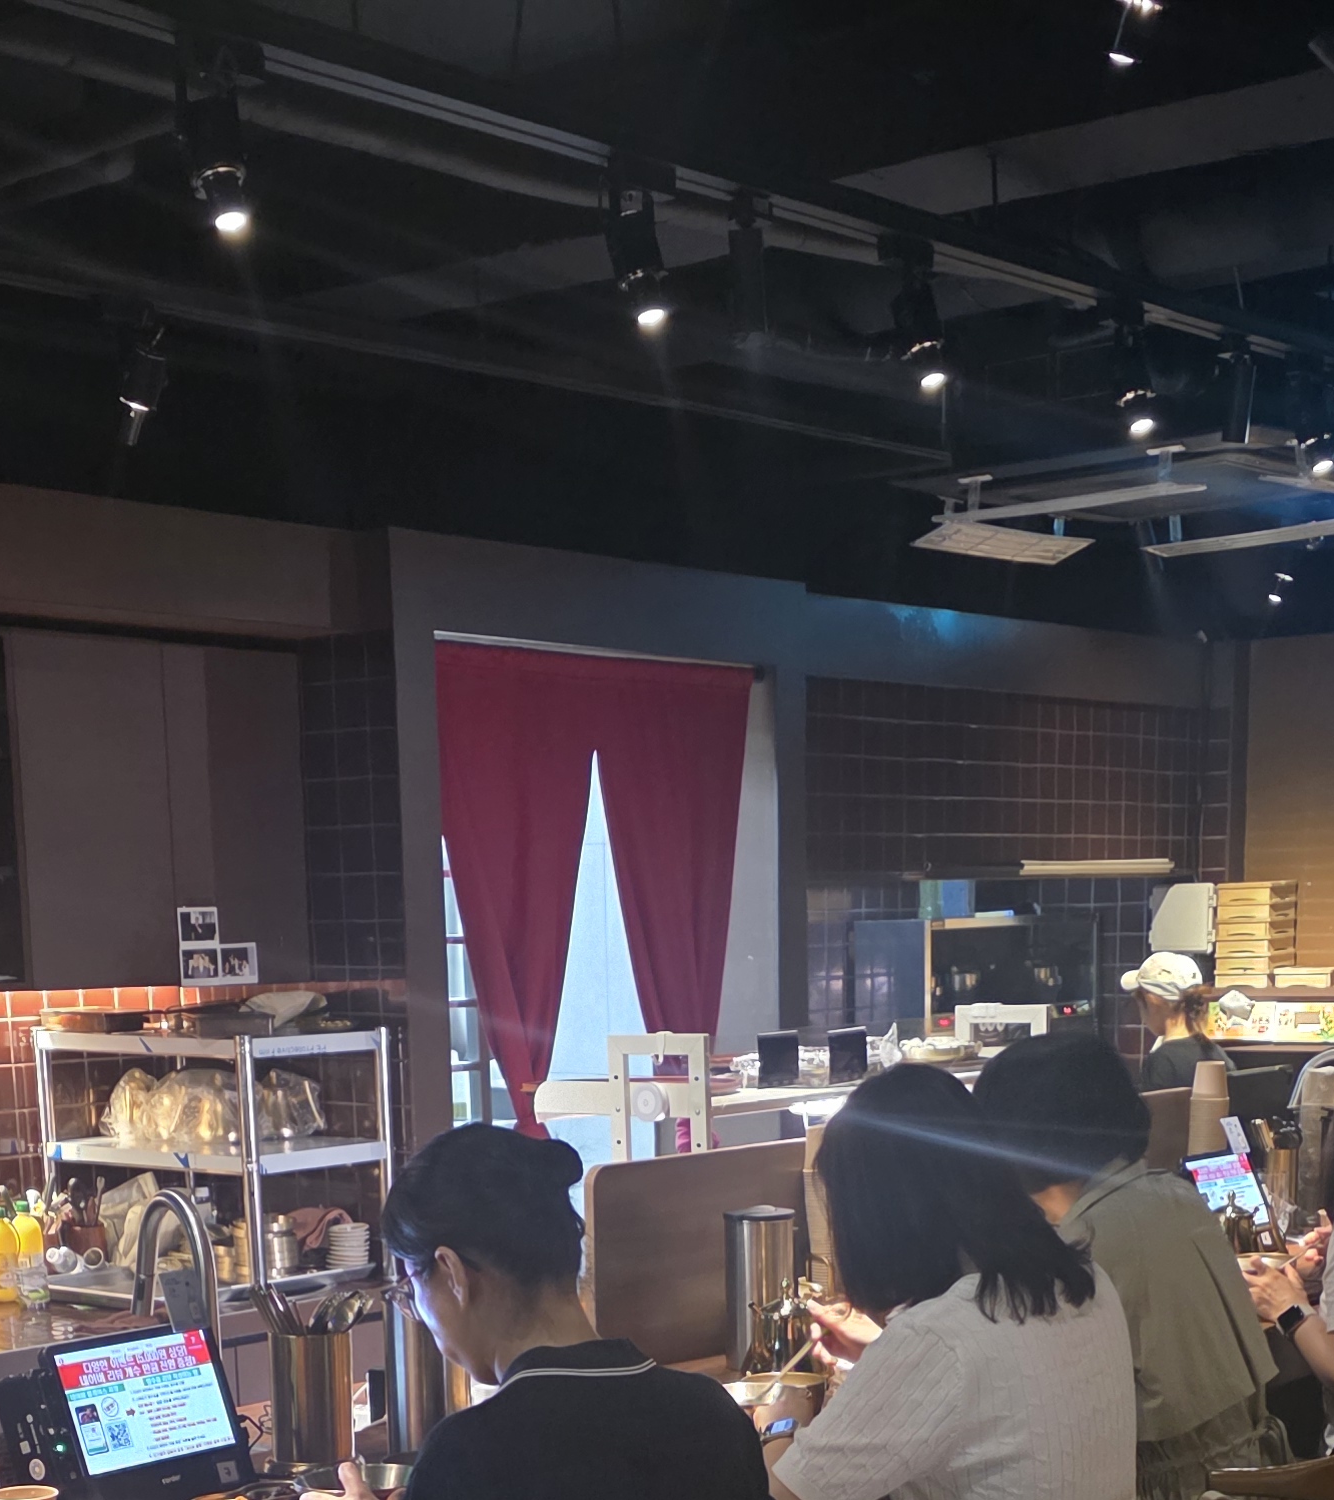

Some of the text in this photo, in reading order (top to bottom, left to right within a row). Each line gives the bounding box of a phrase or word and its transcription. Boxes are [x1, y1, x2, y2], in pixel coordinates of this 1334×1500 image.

[83, 1359, 108, 1372] 다양한
[79, 1371, 106, 1386] 네이버
[107, 1368, 123, 1381] 리뷰
[126, 1366, 141, 1378] 개수
